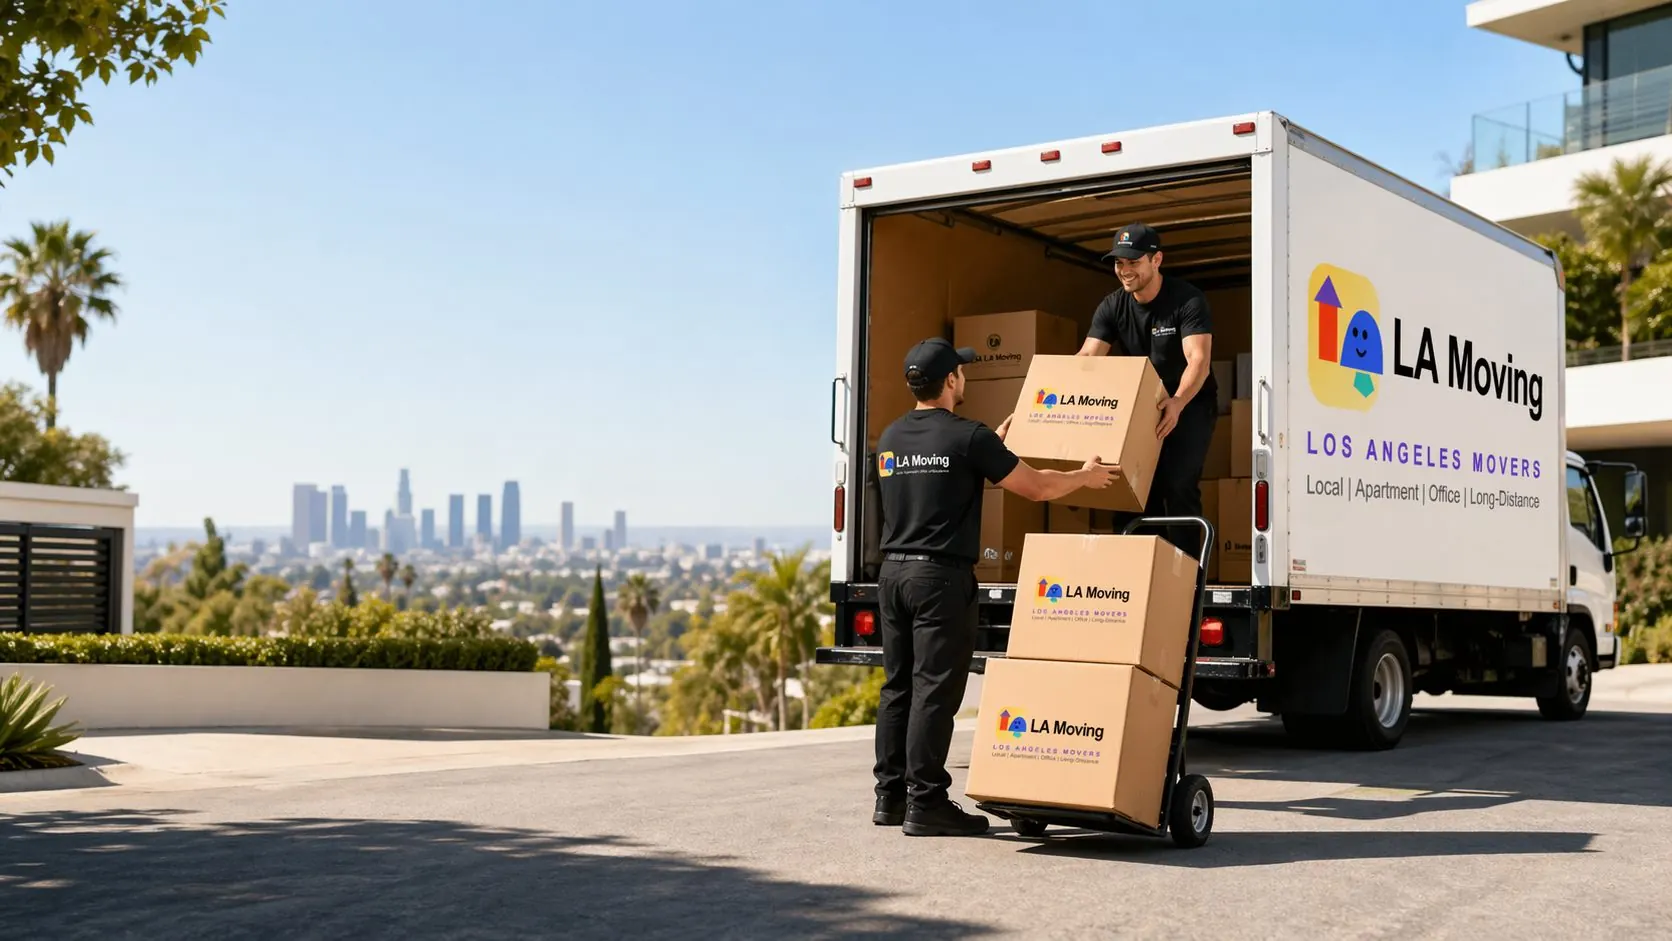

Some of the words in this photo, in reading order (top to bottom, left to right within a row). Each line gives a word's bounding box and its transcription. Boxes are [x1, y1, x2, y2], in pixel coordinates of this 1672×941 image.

[1394, 317, 1439, 384] LA
[1448, 334, 1543, 421] Moving
[1060, 395, 1075, 406] LA
[1078, 395, 1118, 409] Moving
[896, 456, 910, 467] LA
[912, 454, 950, 468] Moving
[1307, 431, 1352, 458] LOS
[1366, 439, 1461, 470] ANGELES
[1473, 452, 1541, 478] MOVERS
[1306, 475, 1344, 496] Local
[1355, 478, 1420, 502] Apartment
[1428, 484, 1460, 504] Office
[1470, 488, 1540, 510] Long-Distance
[1066, 586, 1082, 598] LA
[1086, 586, 1130, 602] Moving
[1030, 719, 1050, 734] LA
[1054, 720, 1104, 742] Moving
